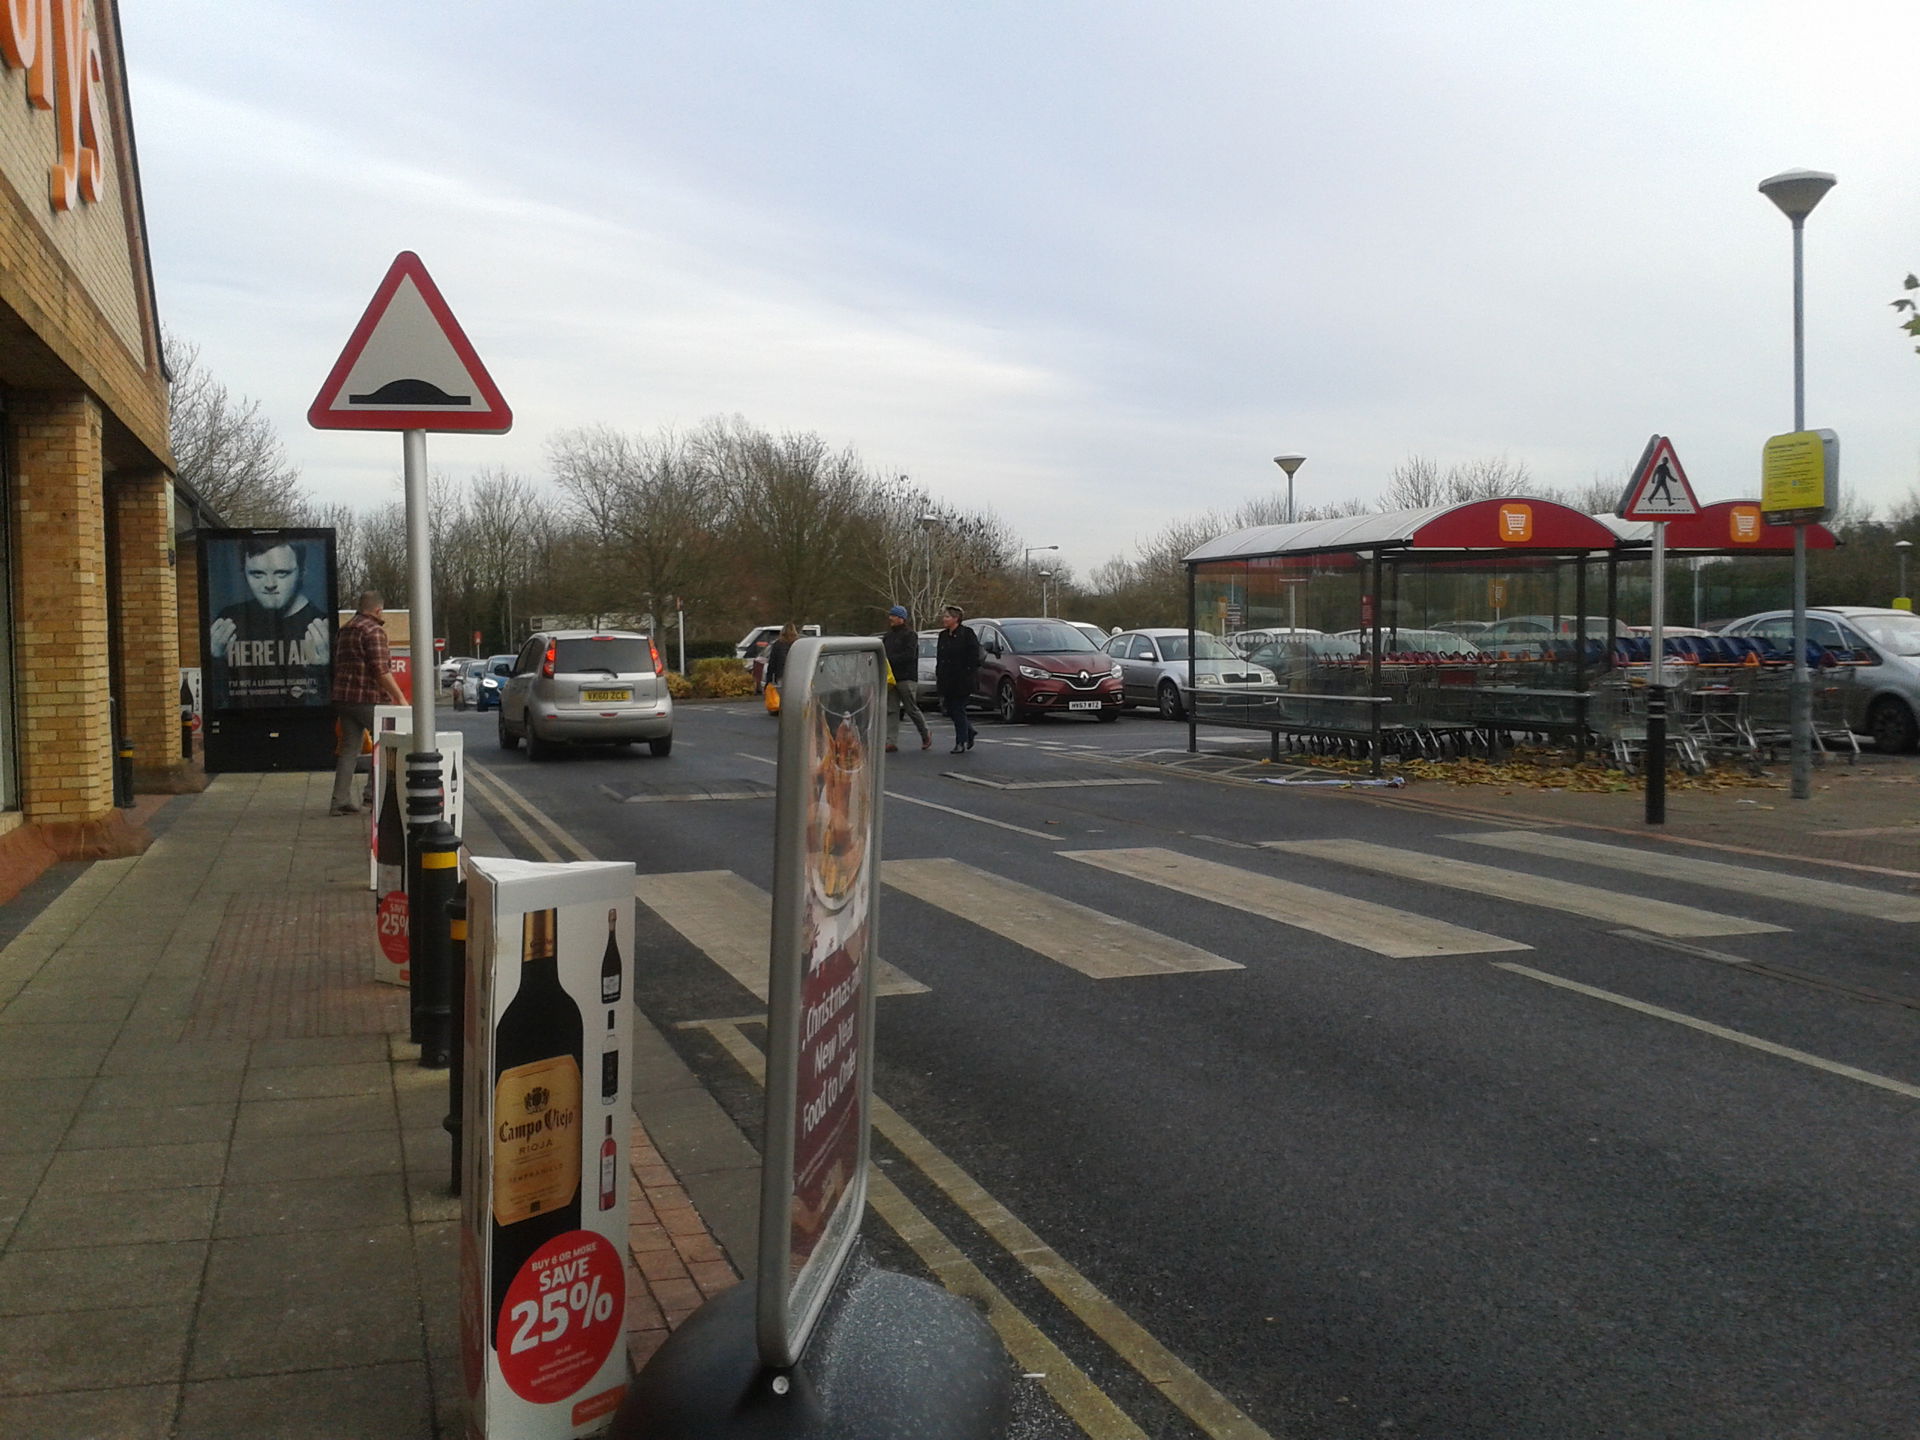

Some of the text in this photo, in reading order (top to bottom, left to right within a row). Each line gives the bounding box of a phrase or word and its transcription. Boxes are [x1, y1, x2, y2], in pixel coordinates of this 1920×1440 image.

[228, 640, 276, 667] HERE
[278, 640, 285, 666] I
[806, 976, 851, 1043] Christmas
[814, 1013, 855, 1078] New Year
[802, 1048, 857, 1140] Food to Order
[499, 1120, 543, 1143] Campo
[518, 1139, 553, 1155] RIOJA
[531, 1241, 598, 1273] BUY 6 OR MORE
[539, 1257, 590, 1293] SAVE
[510, 1275, 613, 1355] 25%
